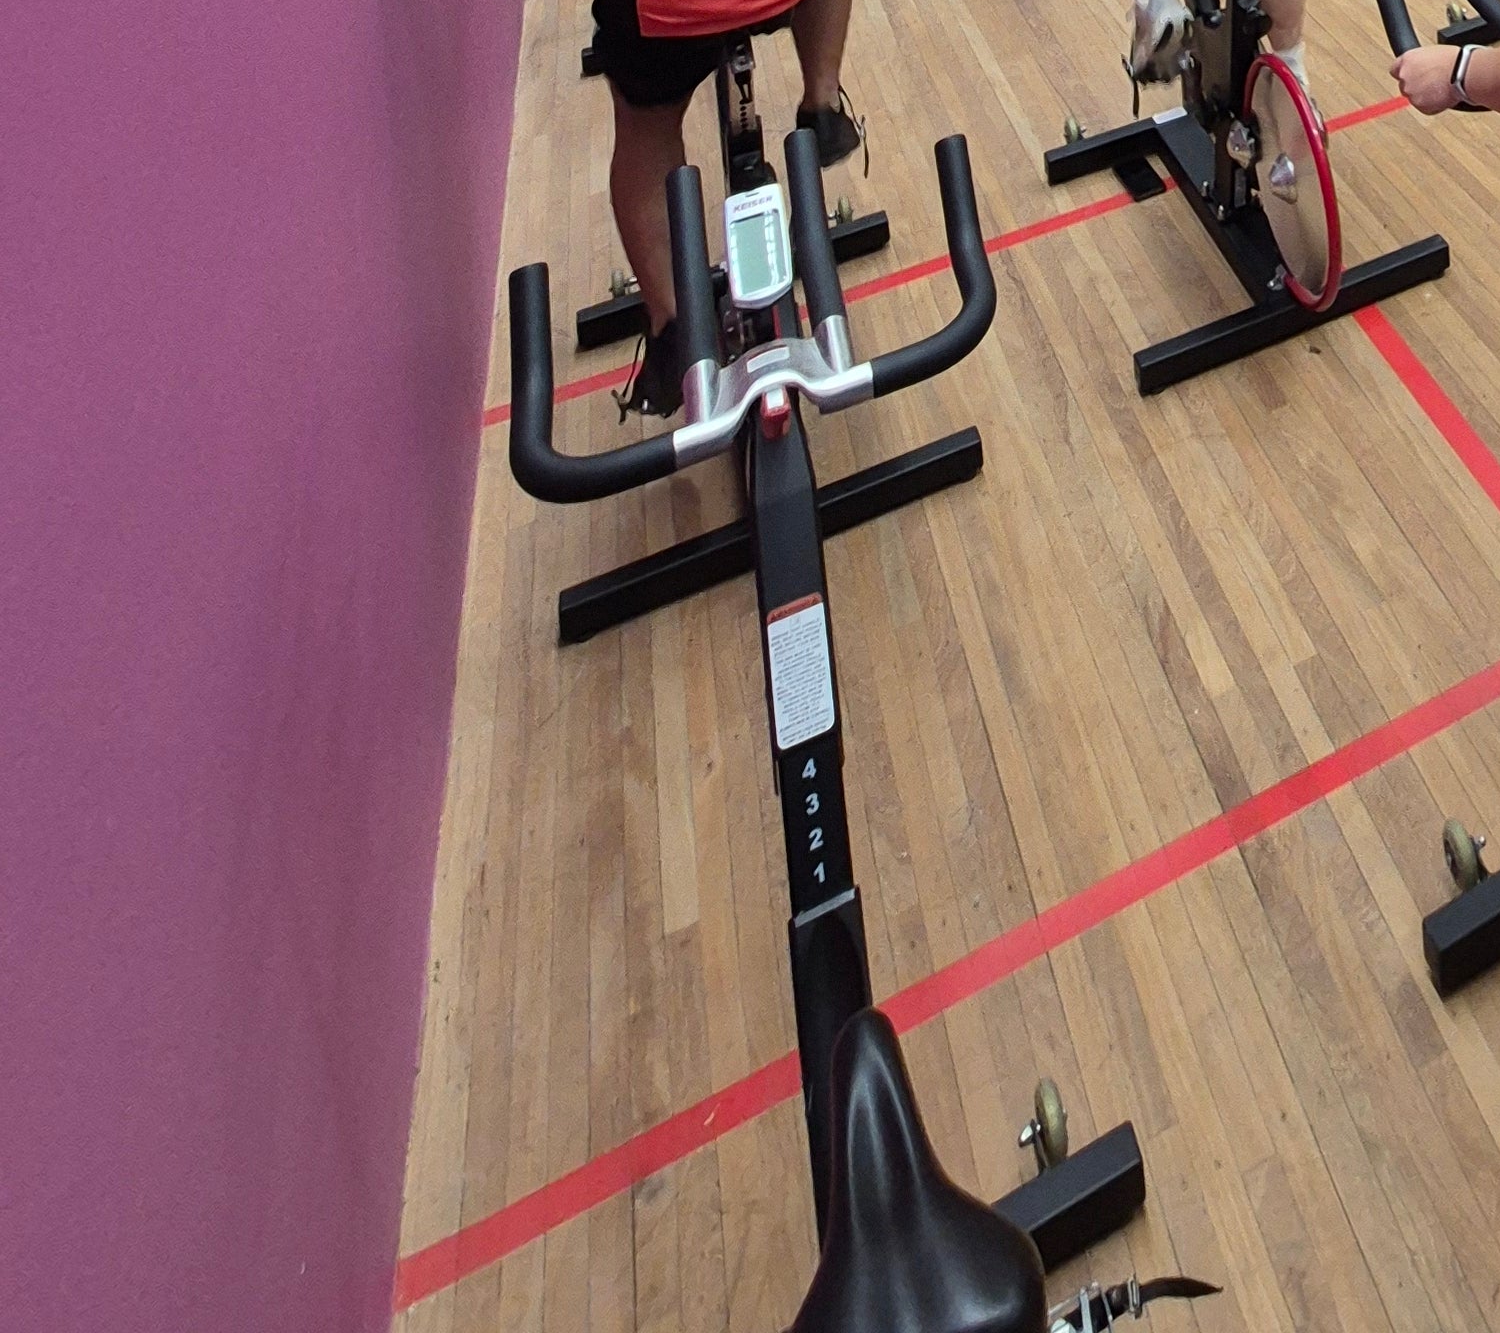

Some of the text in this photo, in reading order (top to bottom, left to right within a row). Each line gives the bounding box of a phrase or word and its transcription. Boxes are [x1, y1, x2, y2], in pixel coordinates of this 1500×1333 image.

[733, 195, 773, 214] KEISER
[801, 757, 817, 779] 4
[805, 792, 820, 816] 3
[808, 827, 824, 852] 2
[813, 861, 826, 883] 1
